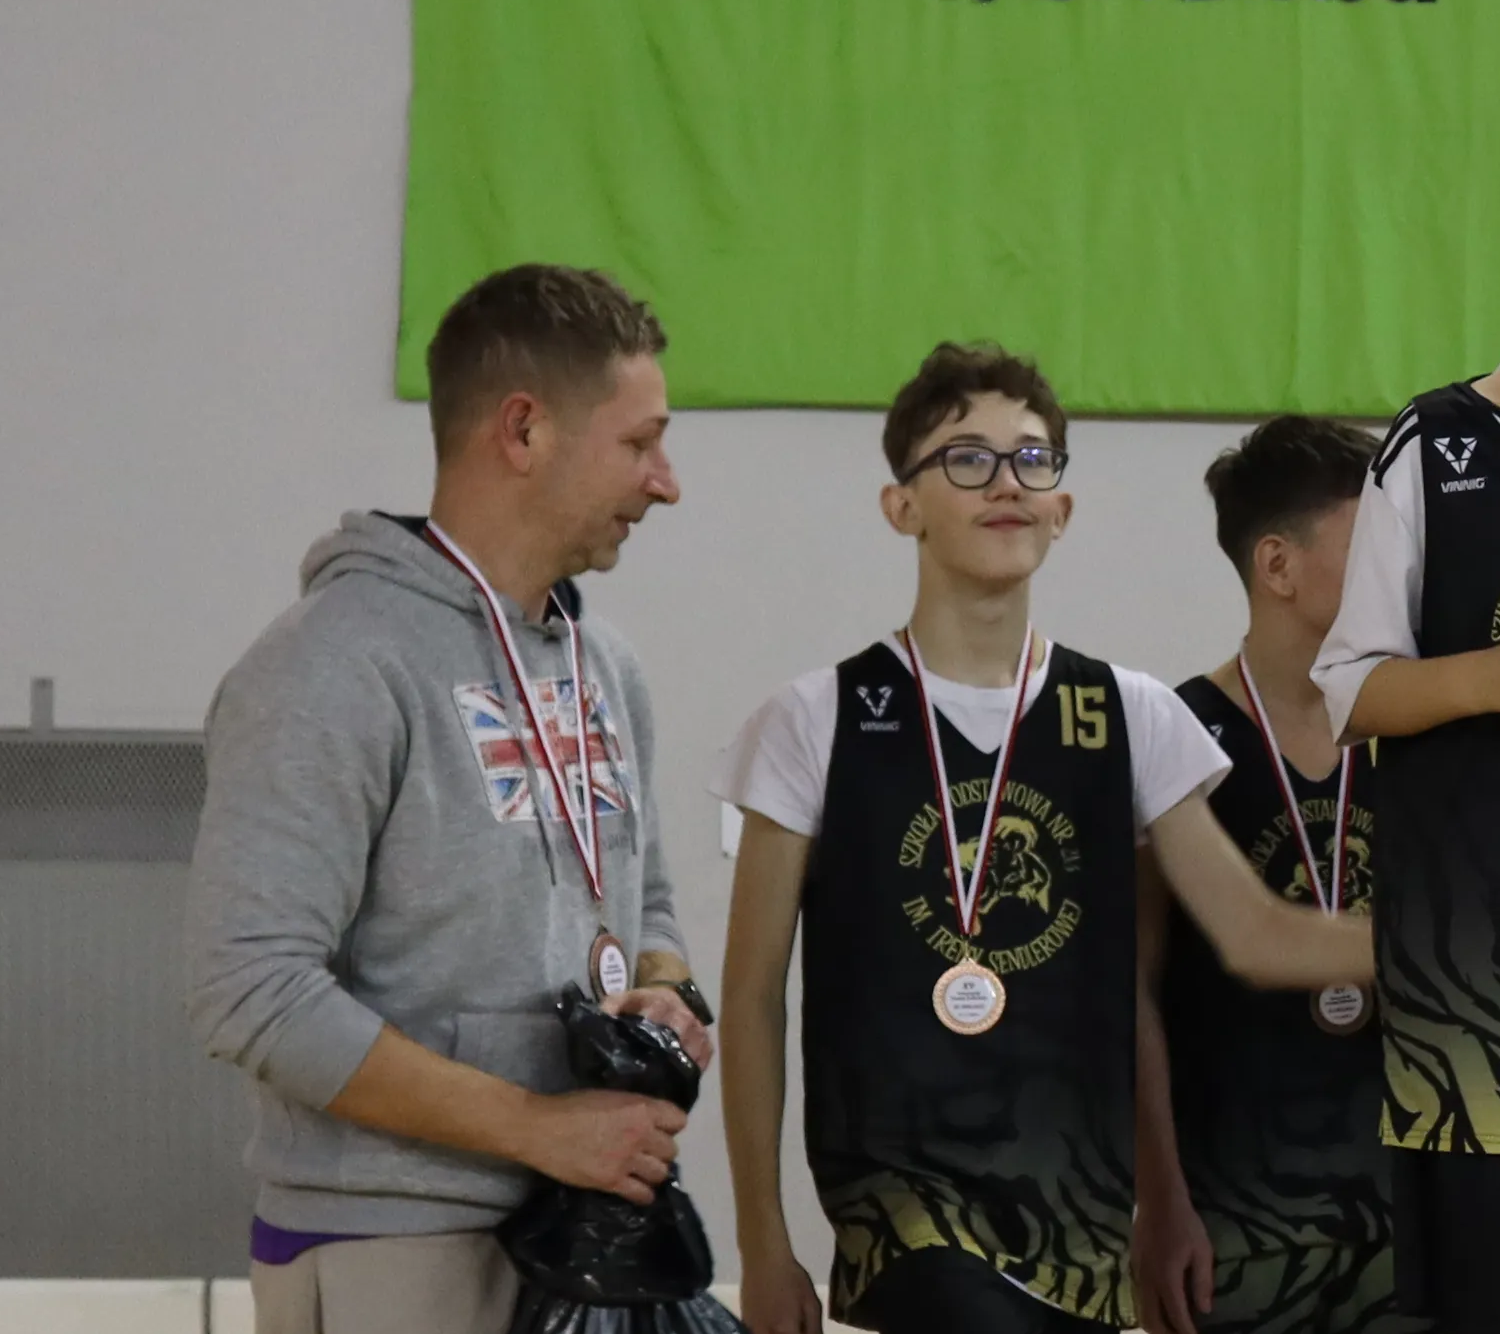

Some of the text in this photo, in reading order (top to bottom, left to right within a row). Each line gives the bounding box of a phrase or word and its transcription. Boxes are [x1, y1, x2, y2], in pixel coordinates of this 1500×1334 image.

[1440, 476, 1487, 494] VINNIG
[1056, 683, 1109, 750] 15
[898, 802, 942, 868] SZKOŁA
[1046, 812, 1075, 846] NR
